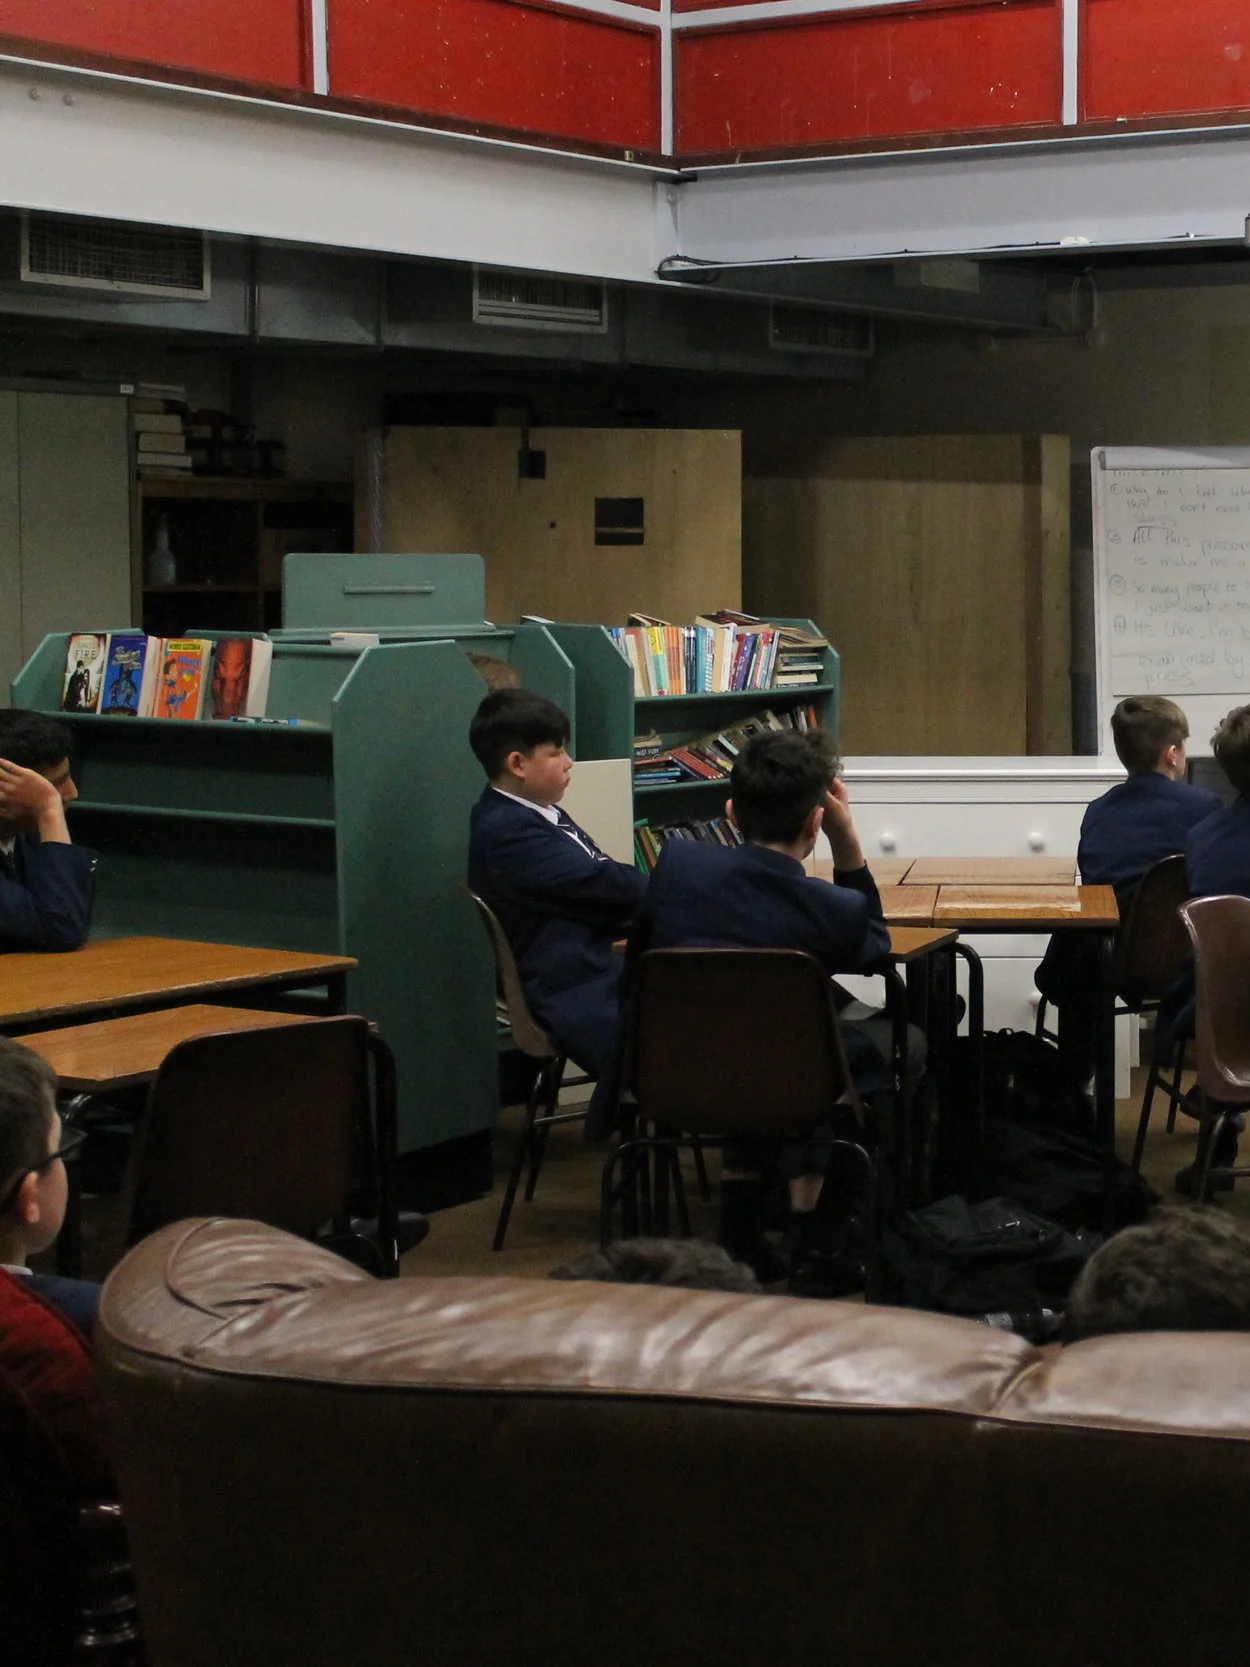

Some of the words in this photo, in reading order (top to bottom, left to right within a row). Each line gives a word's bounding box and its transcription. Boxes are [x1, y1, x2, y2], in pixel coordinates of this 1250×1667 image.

[1186, 580, 1220, 598] people
[1226, 581, 1237, 594] to
[76, 649, 96, 659] FIRE
[1224, 648, 1245, 679] by
[1145, 670, 1195, 690] press
